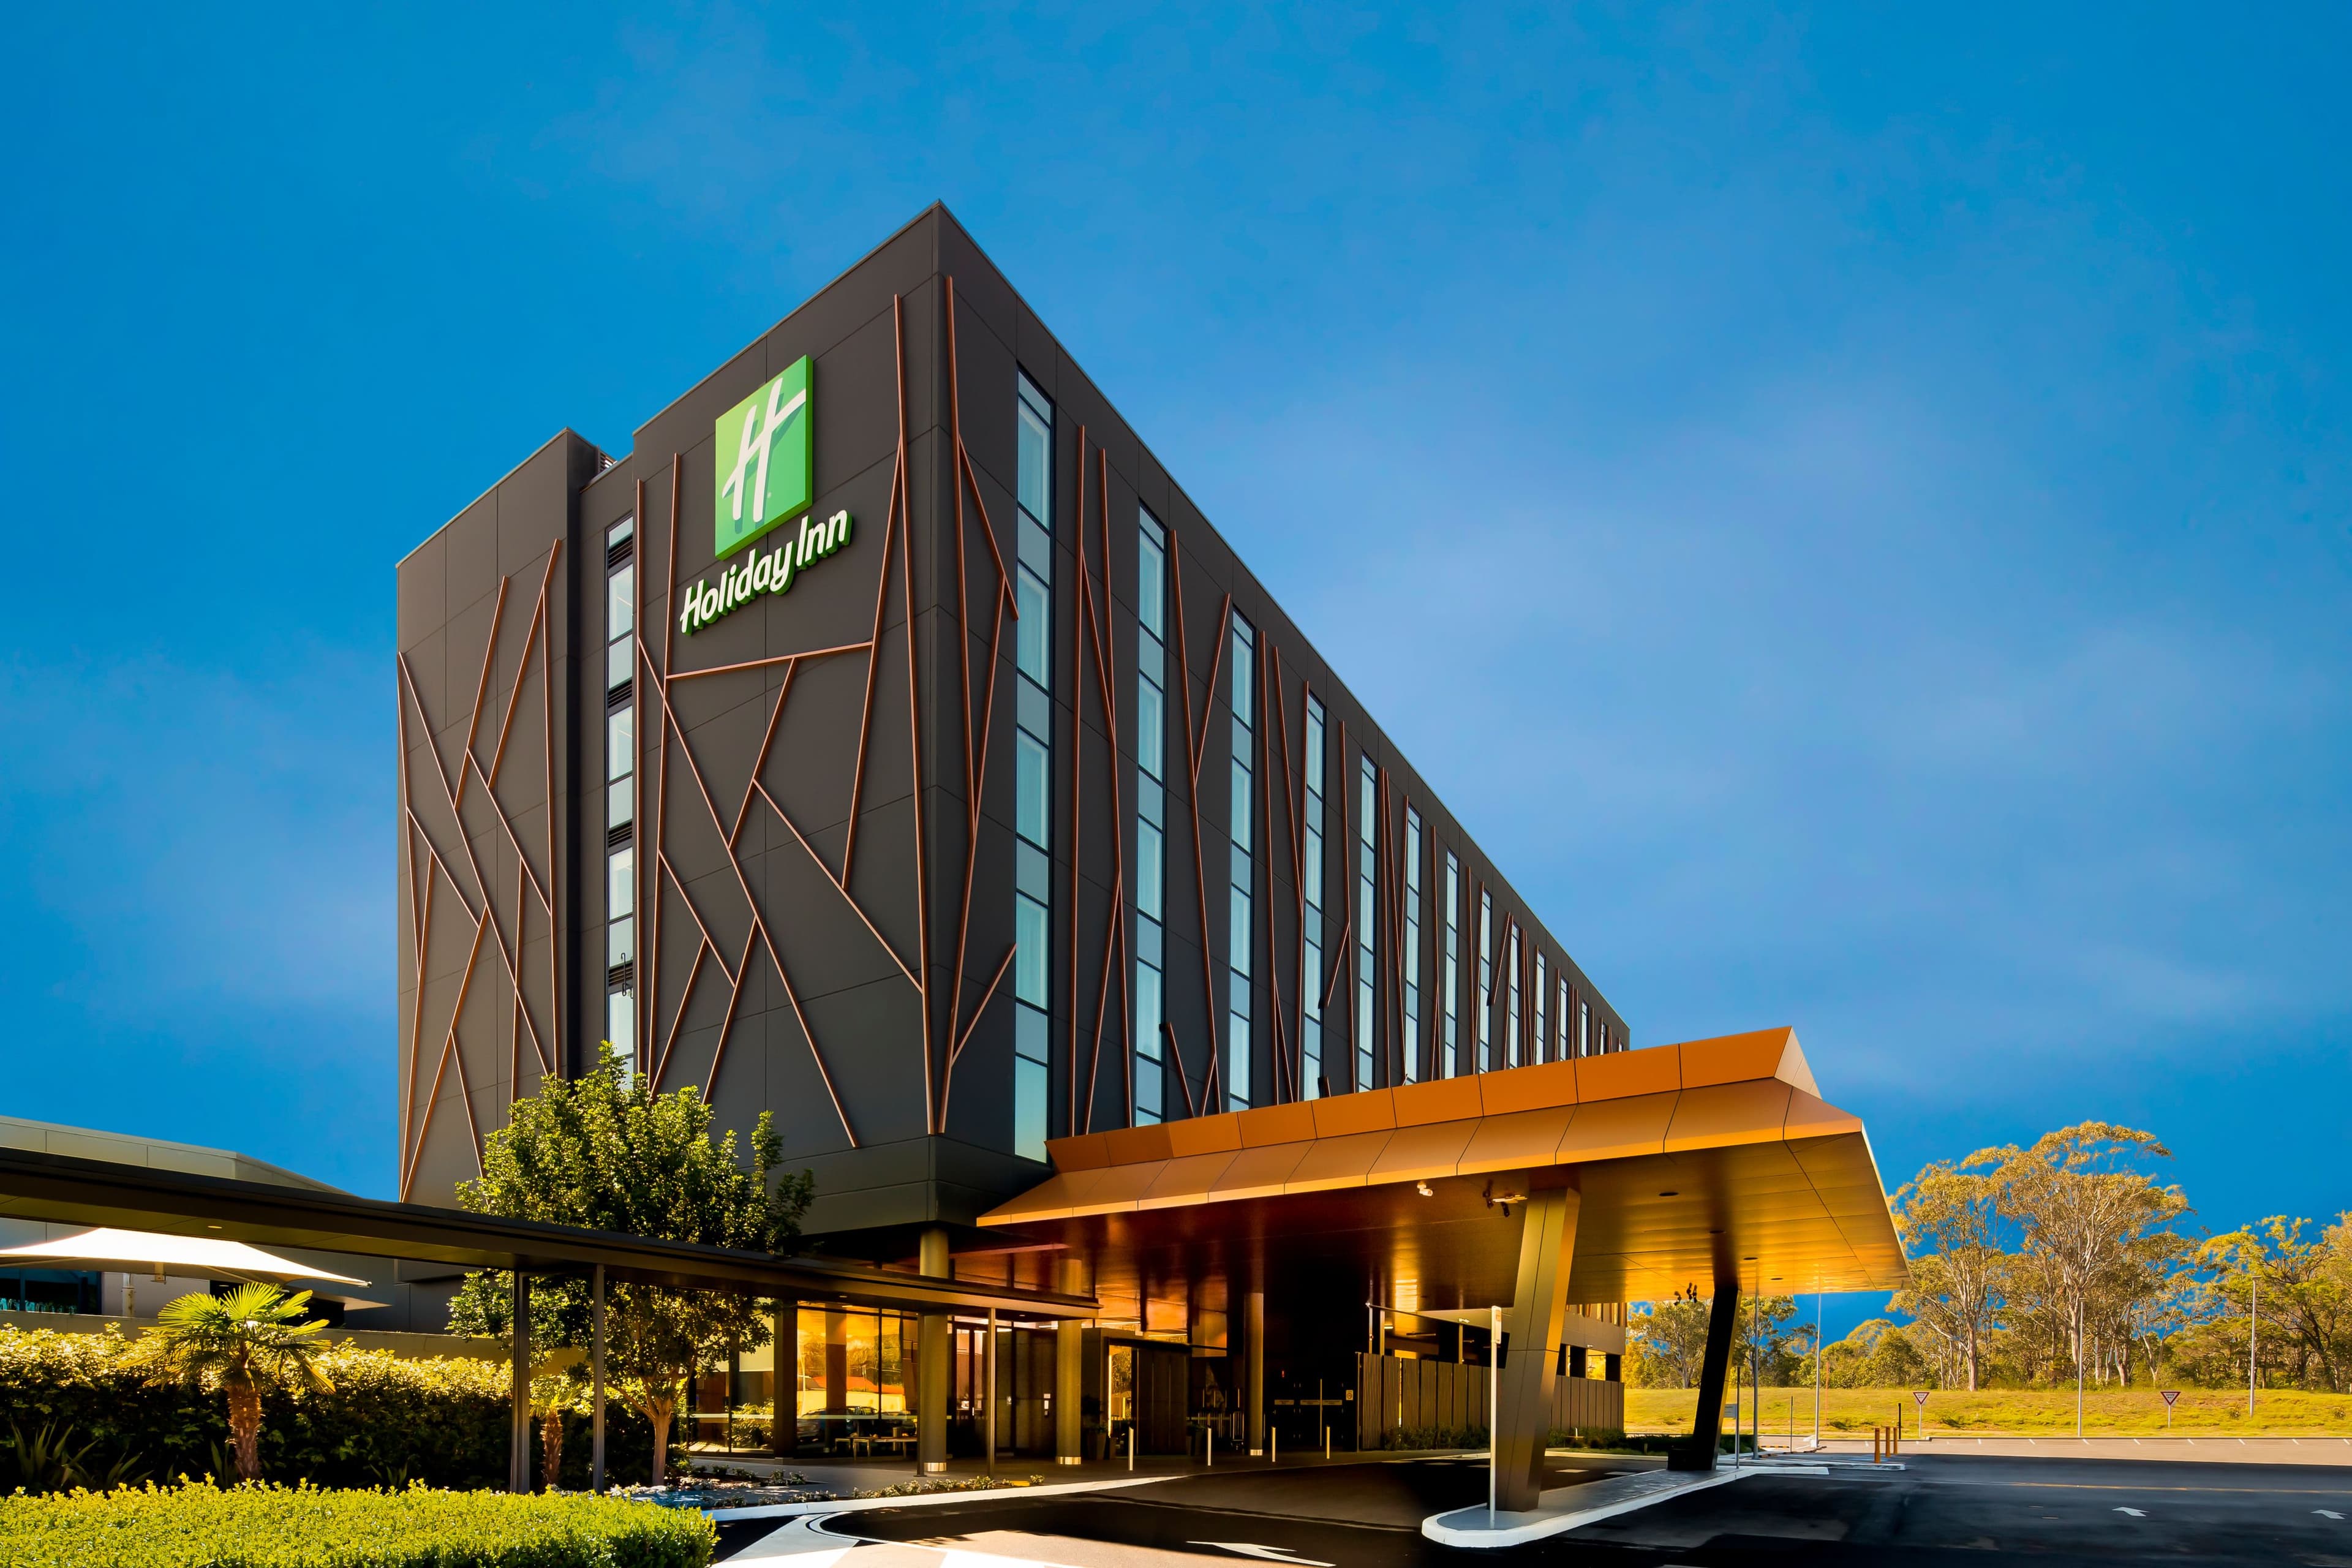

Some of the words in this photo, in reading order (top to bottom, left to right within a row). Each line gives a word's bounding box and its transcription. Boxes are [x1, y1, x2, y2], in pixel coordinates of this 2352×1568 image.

[722, 377, 806, 522] H
[680, 540, 794, 635] Holiday
[796, 509, 850, 568] Inn
